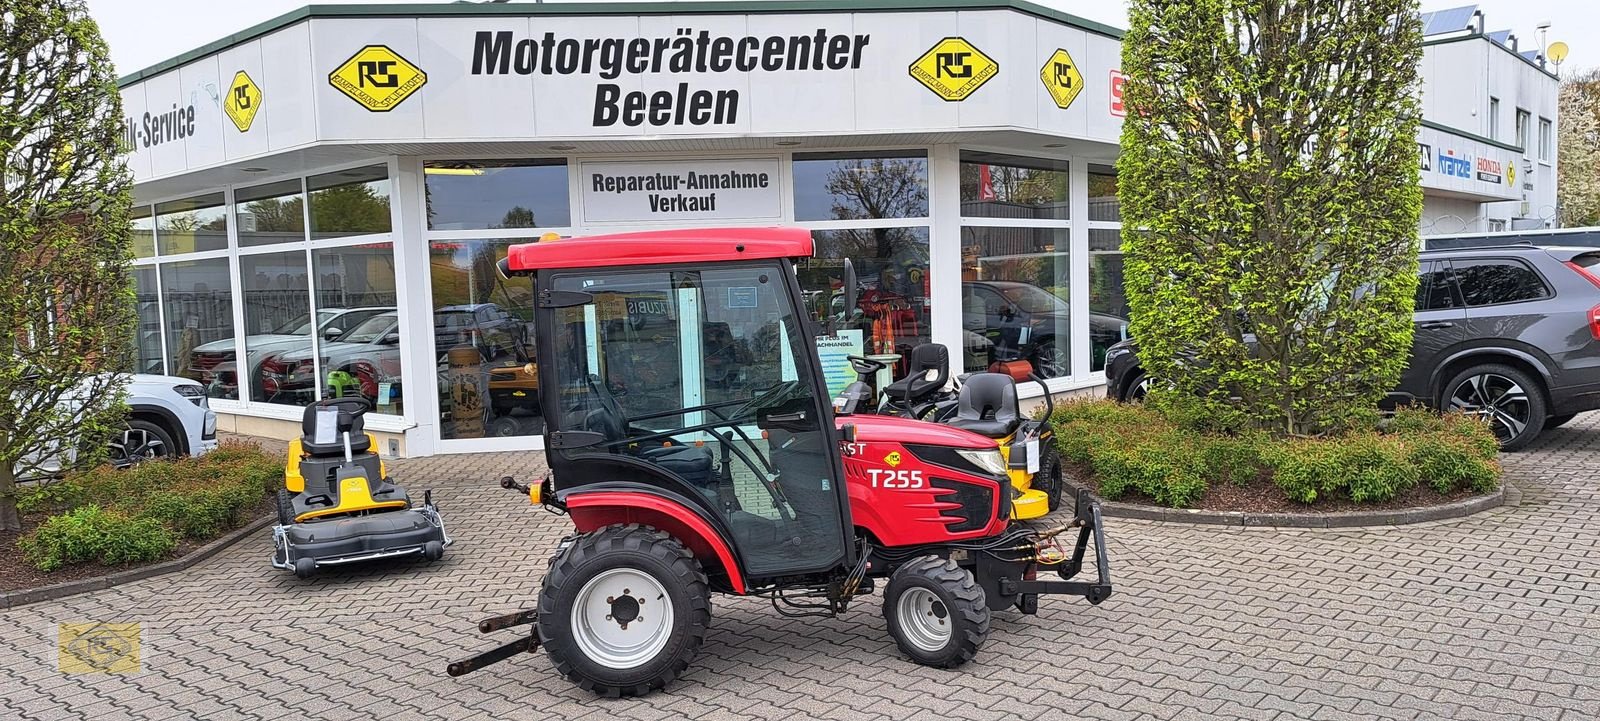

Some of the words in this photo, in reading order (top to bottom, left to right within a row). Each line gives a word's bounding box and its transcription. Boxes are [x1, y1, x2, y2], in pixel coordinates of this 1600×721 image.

[472, 28, 870, 79] Motorgerätecenter
[936, 53, 971, 78] RS
[358, 61, 398, 88] RS
[1053, 61, 1071, 88] RS
[234, 83, 251, 112] RS
[592, 82, 739, 127] Beelen
[1477, 157, 1501, 174] HONDA
[592, 170, 769, 193] Reparatur-Annahme
[648, 193, 716, 212] Verkauf
[867, 469, 923, 488] T255
